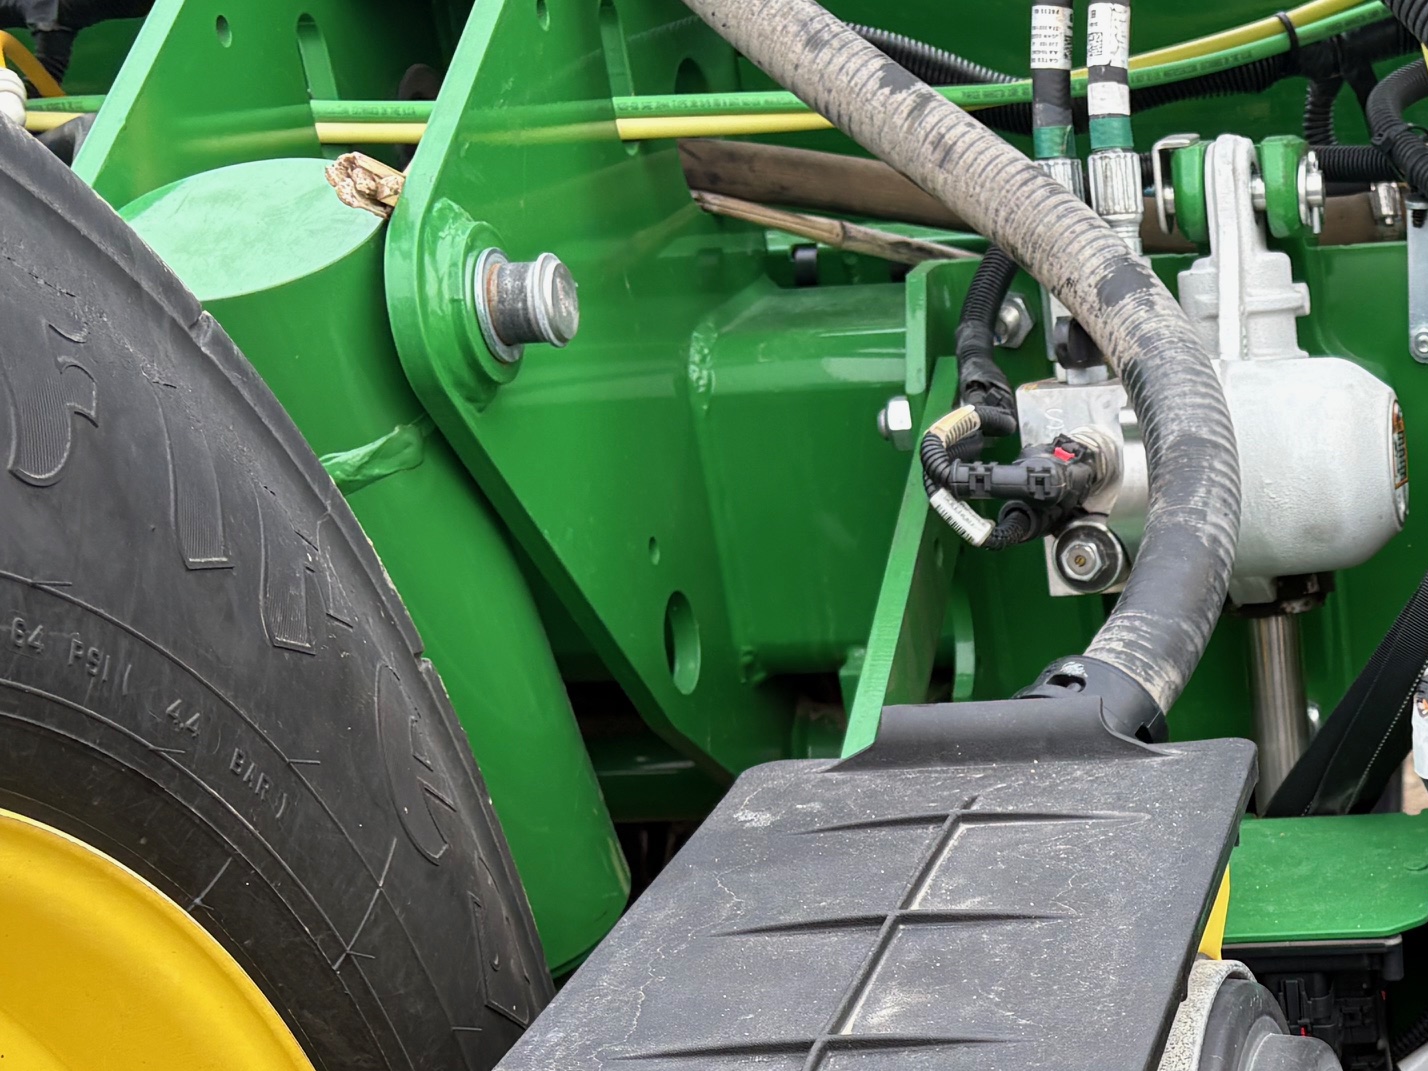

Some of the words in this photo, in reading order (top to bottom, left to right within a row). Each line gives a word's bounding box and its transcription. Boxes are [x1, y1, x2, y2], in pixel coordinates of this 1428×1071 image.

[11, 617, 45, 655] 64
[68, 638, 111, 682] PSI
[230, 748, 273, 800] BAR
